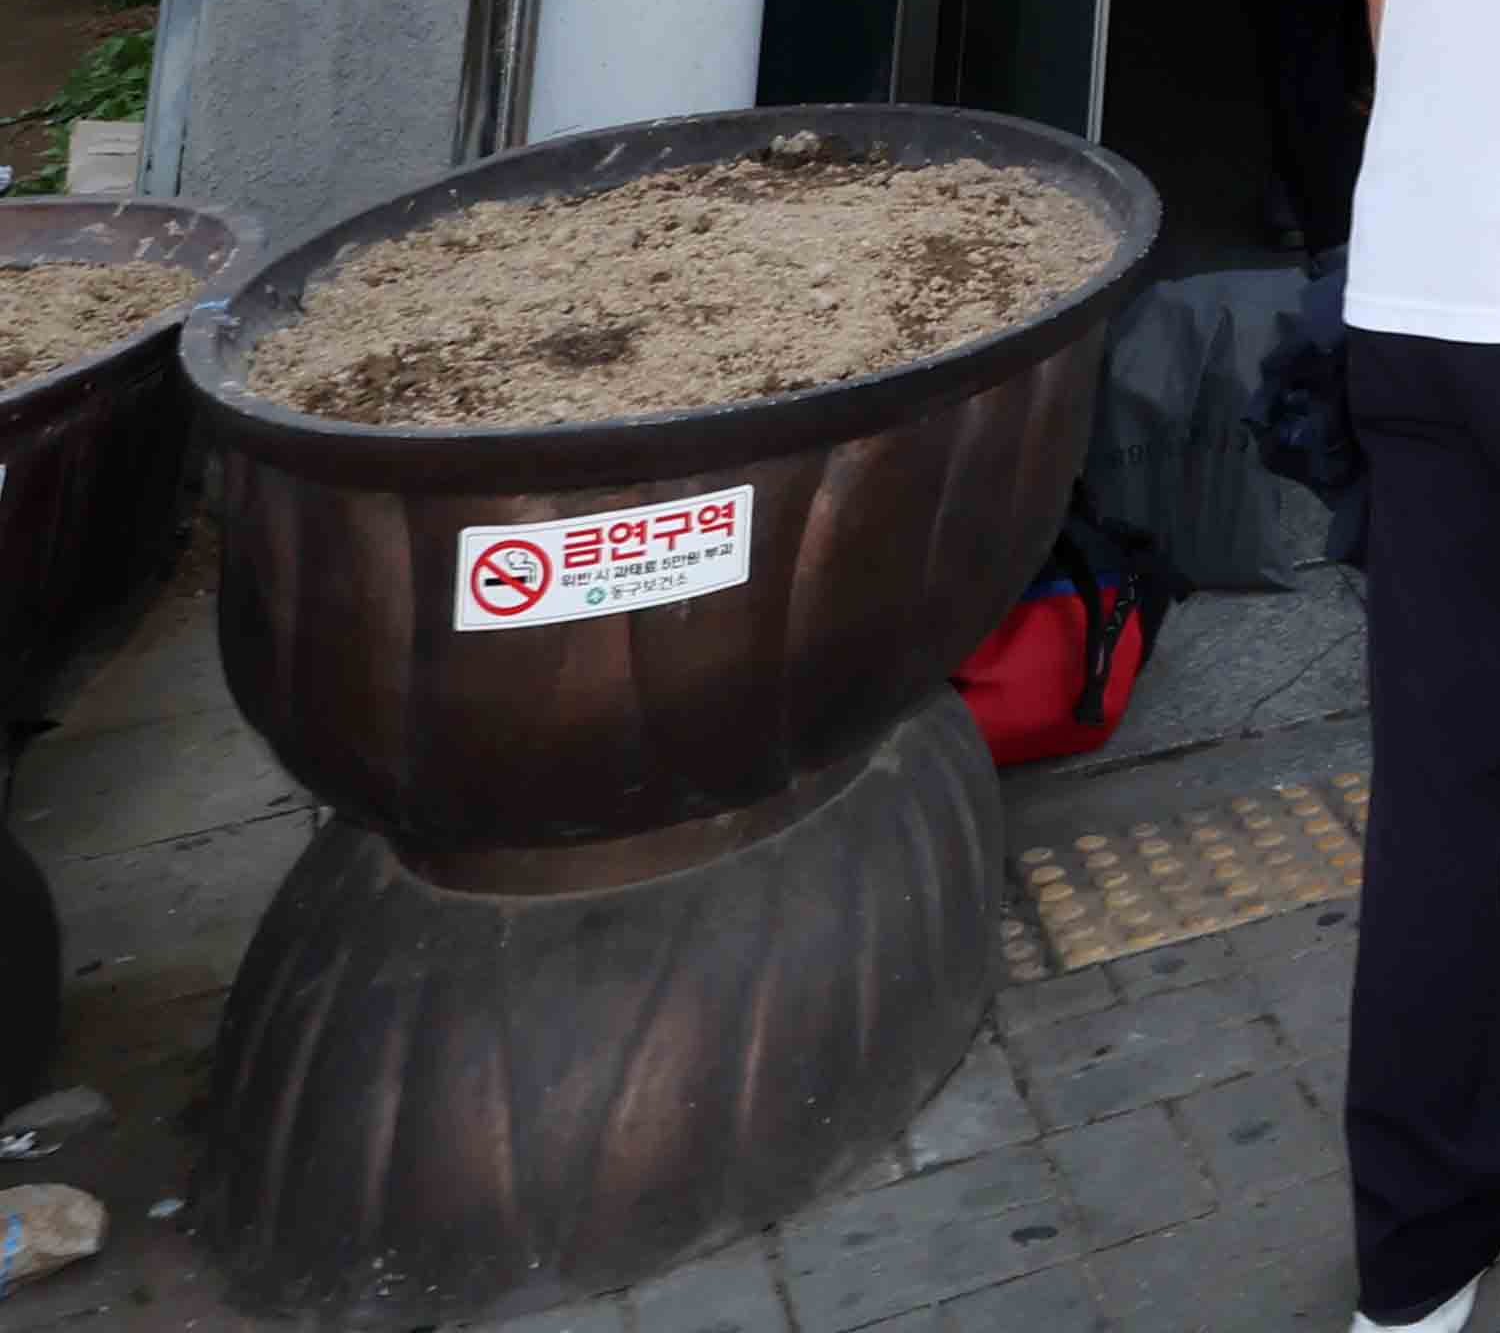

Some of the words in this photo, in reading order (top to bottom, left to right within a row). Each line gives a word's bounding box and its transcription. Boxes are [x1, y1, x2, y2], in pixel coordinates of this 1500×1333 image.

[564, 501, 735, 569] 금연구역
[561, 573, 591, 587] 위반
[595, 568, 609, 581] 시
[613, 561, 656, 577] 과태료
[662, 549, 700, 570] 5만원
[704, 543, 733, 557] 부과
[612, 573, 687, 598] 동구보건소
